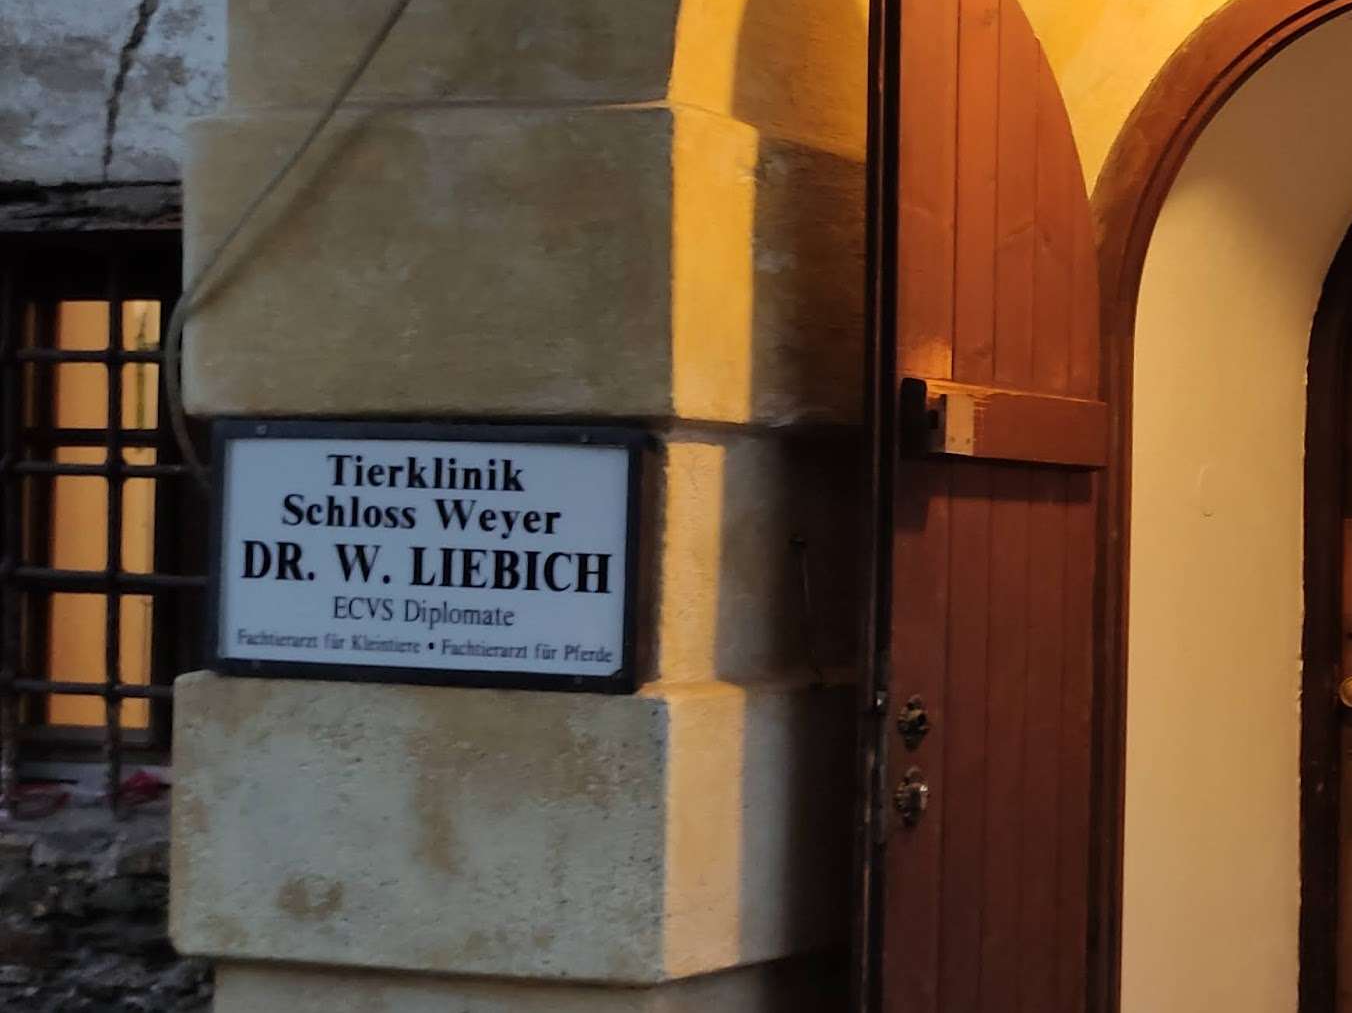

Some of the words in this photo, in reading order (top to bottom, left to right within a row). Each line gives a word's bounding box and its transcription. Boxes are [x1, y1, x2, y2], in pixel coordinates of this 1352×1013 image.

[327, 454, 524, 491] Tierklinik
[282, 494, 416, 529] Schloss
[435, 499, 561, 539] Weyer
[241, 540, 315, 581] DR.
[334, 543, 391, 584] W.
[409, 547, 612, 593] LIEBICH
[333, 596, 394, 621] ECVS
[404, 599, 515, 630] Diplomate
[237, 629, 318, 649] Fachtierarzt
[324, 633, 345, 650] für
[351, 635, 421, 654] Kleintiere
[441, 639, 528, 659] Fachtierarzt
[535, 644, 557, 660] für
[564, 644, 613, 663] Pferde
